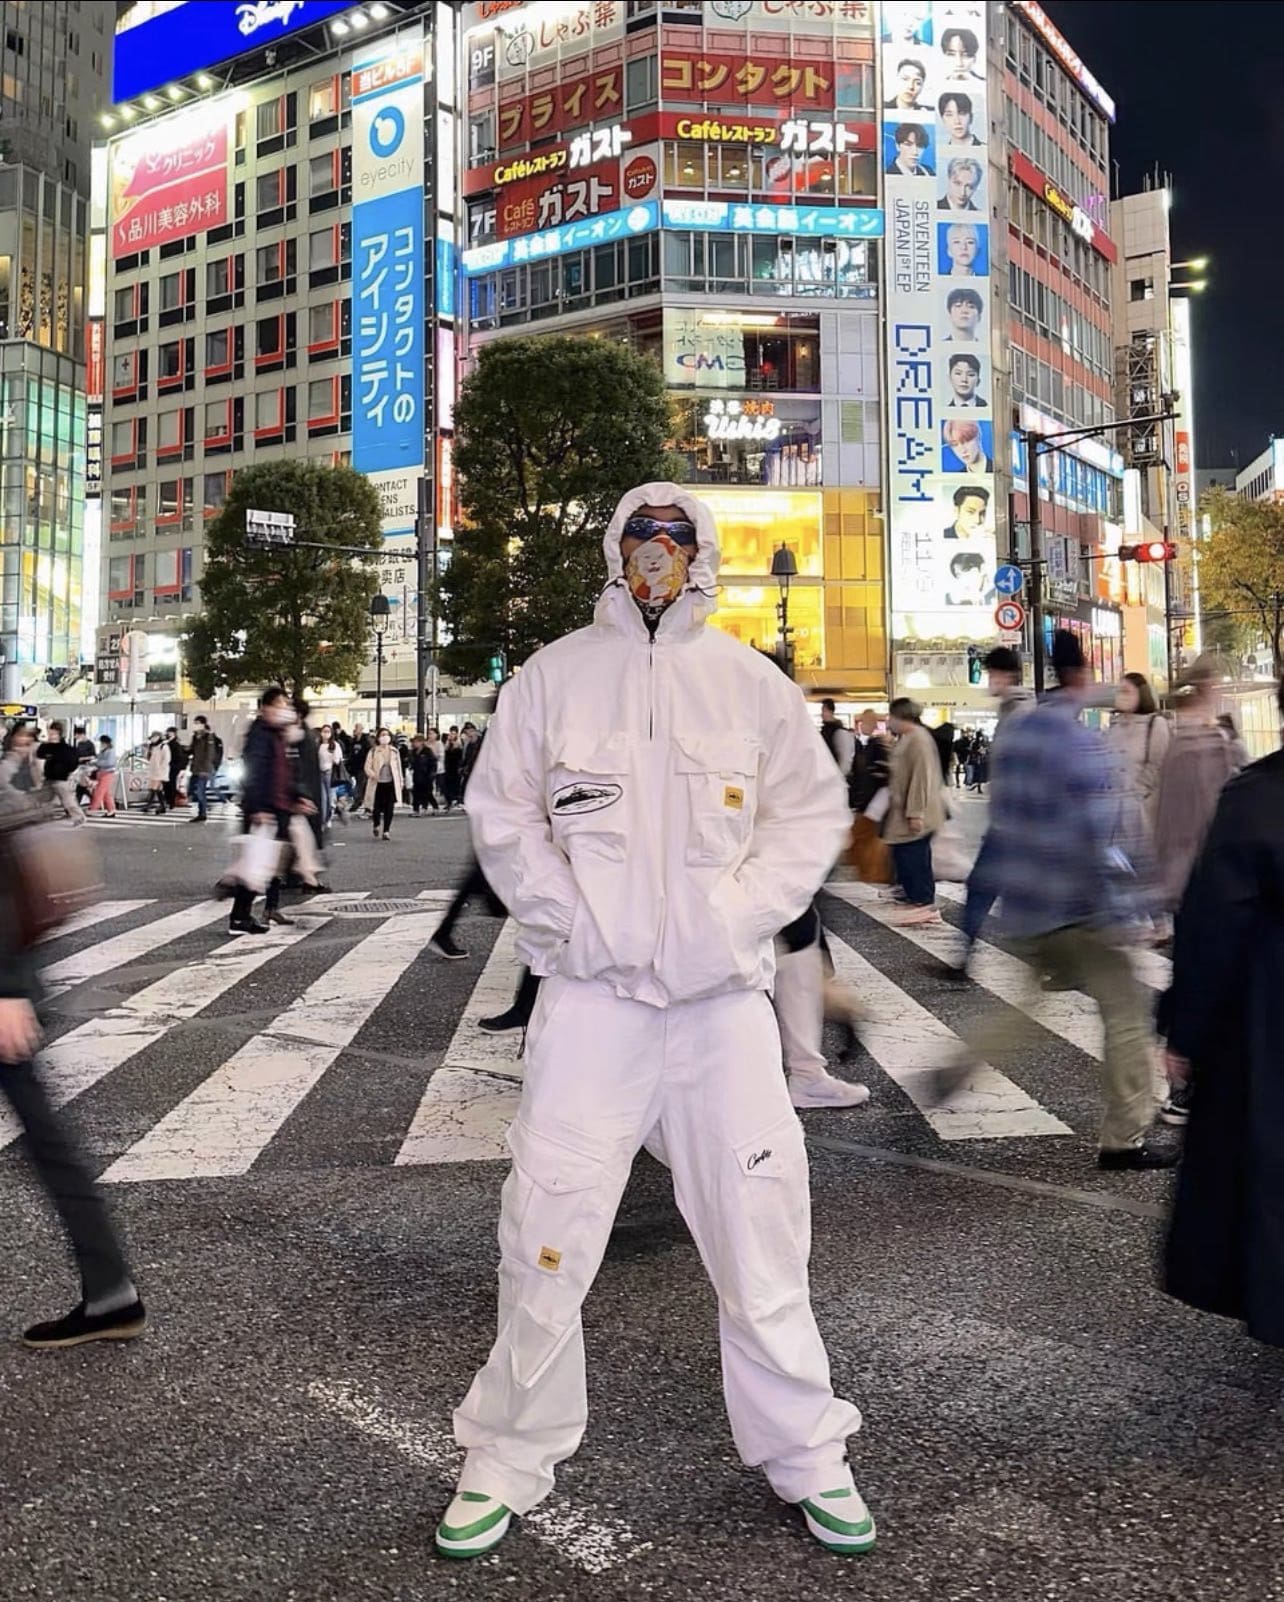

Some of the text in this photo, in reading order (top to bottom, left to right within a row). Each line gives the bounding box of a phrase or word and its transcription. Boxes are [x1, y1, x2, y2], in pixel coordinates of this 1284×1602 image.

[472, 47, 493, 70] 9F
[663, 59, 830, 98] コンタクト
[500, 71, 622, 139] プライス
[570, 124, 631, 169] ガスト
[780, 119, 858, 152] ガスト
[161, 142, 215, 174] クリニック
[360, 158, 414, 188] eyecity
[128, 189, 221, 242] 品川美容外科
[471, 210, 496, 237] 7F
[503, 199, 534, 222] Café
[538, 177, 612, 229] ガスト
[896, 198, 910, 250] JAPAN
[915, 201, 930, 292] SEVENTEEN
[897, 273, 911, 292] EP
[360, 234, 389, 427] アイシティ
[393, 226, 415, 423] コンタクトの
[896, 324, 934, 501] DREAM
[374, 479, 408, 493] ONTACT
